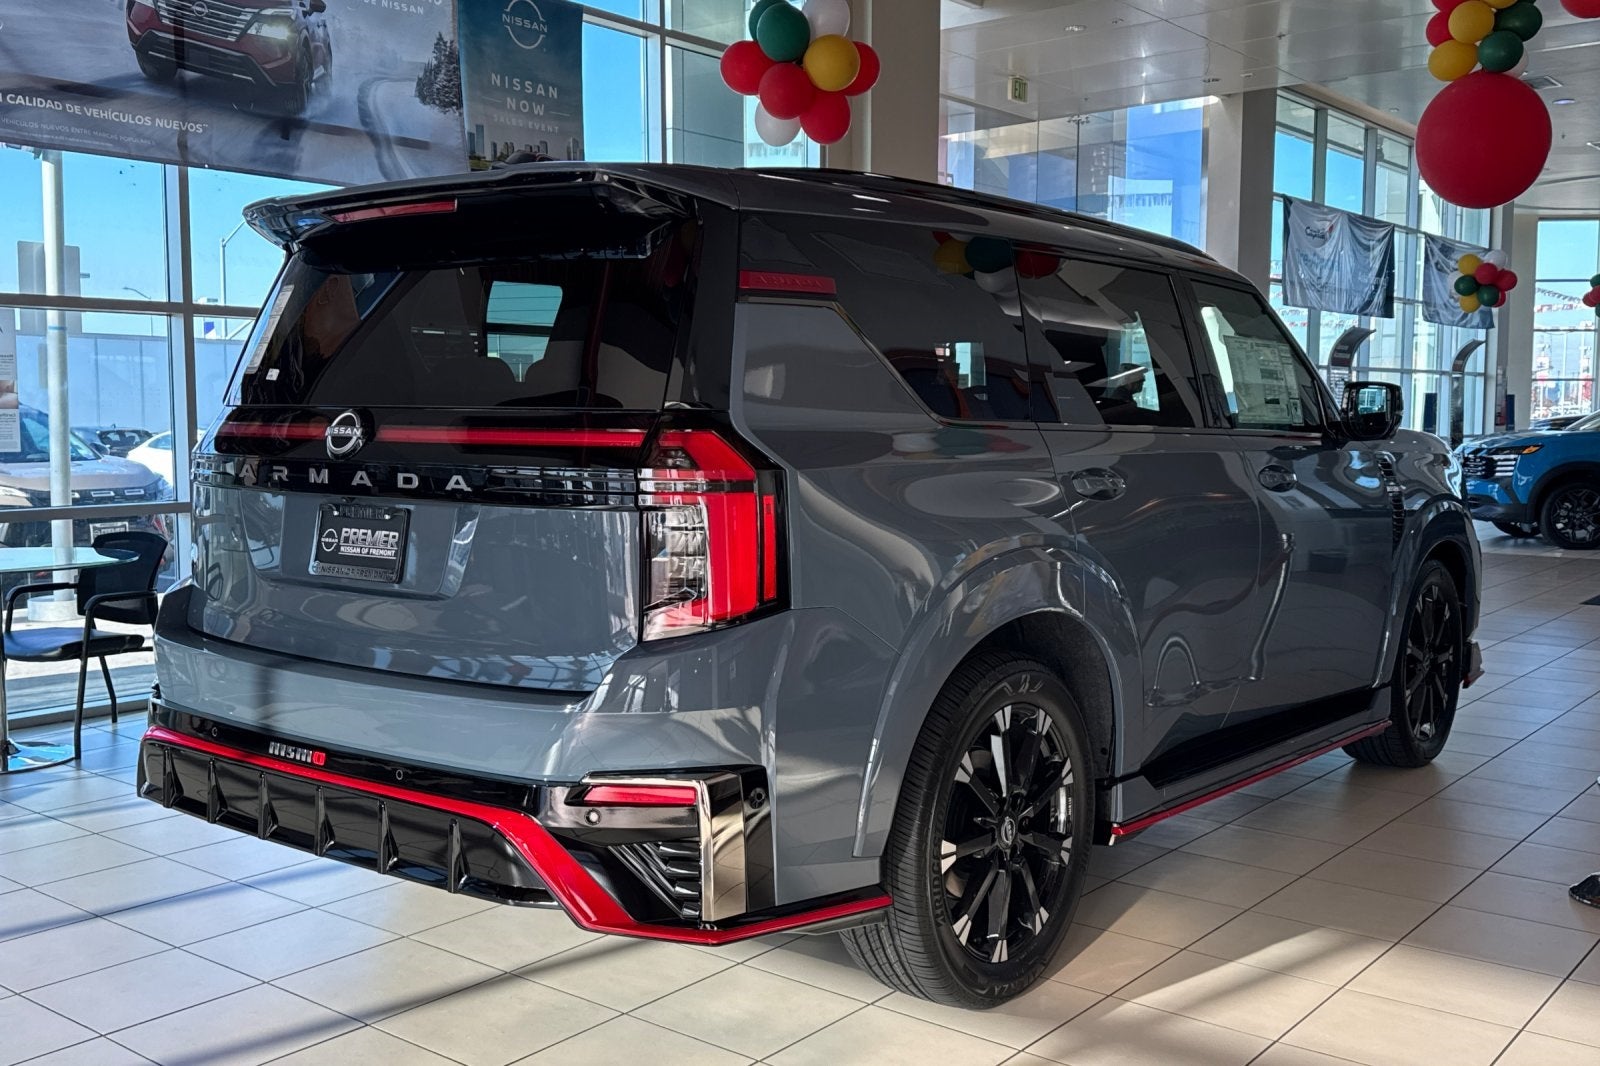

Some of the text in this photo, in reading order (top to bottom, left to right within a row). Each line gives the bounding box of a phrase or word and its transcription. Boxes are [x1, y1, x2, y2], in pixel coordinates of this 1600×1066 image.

[381, 0, 424, 15] NISSAN
[502, 13, 548, 33] NISSAN
[491, 72, 558, 99] NISSAN
[1014, 80, 1028, 103] EXIT
[7, 93, 63, 111] CALIDAD
[66, 103, 82, 115] DE
[84, 106, 152, 126] VEHÍCULOS
[506, 96, 545, 116] NOW
[528, 120, 560, 133] EVENT
[325, 425, 362, 437] NISSAN
[237, 463, 472, 492] ARMADA
[340, 527, 399, 548] PREMIER
[369, 549, 396, 557] FREMONT
